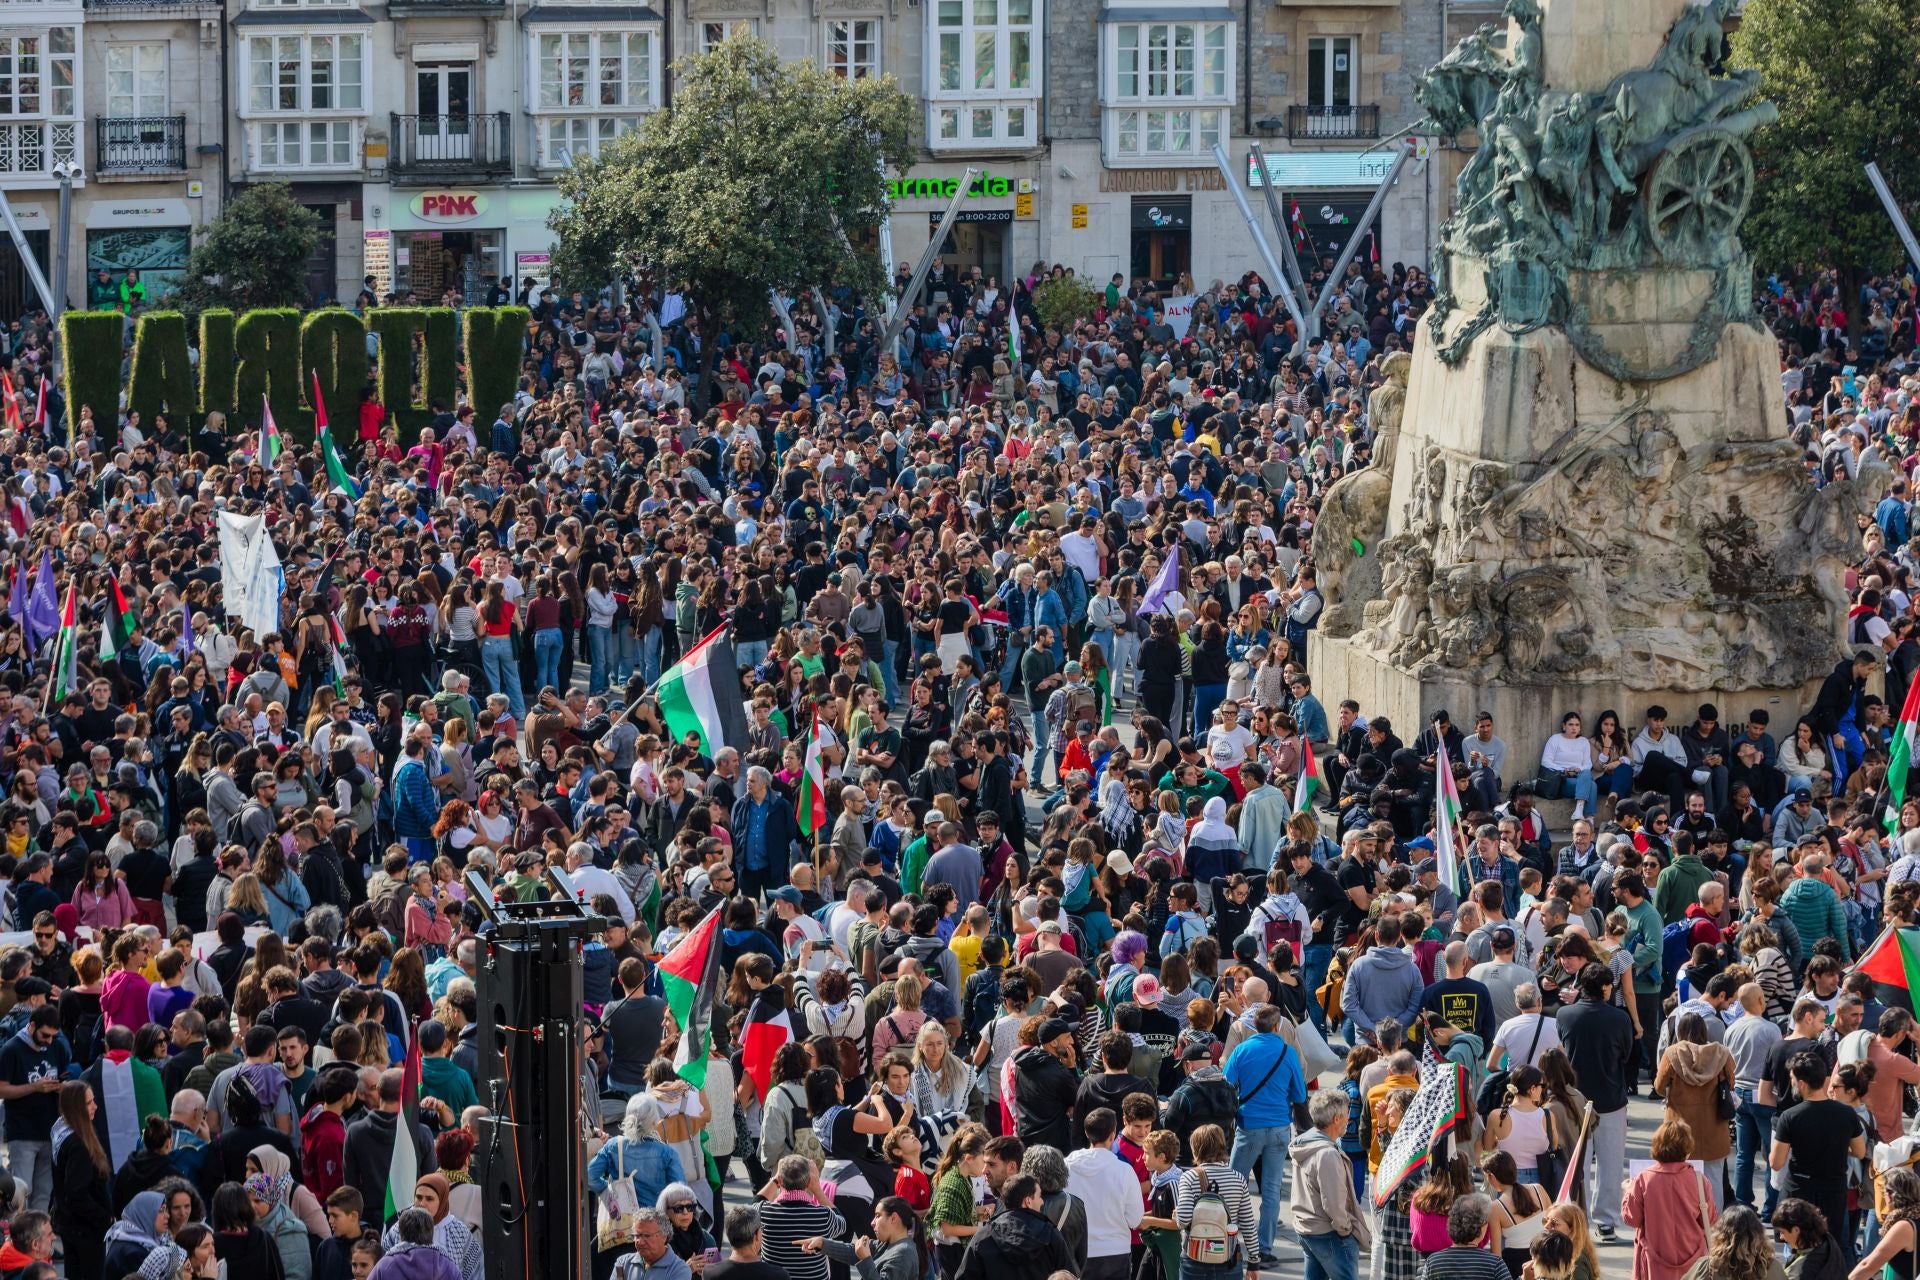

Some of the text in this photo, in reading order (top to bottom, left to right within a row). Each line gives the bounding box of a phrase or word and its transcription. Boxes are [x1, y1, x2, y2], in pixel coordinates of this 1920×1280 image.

[886, 170, 1009, 199] armacia
[1099, 170, 1227, 192] LANDABURU ETXEA
[965, 212, 1010, 221] 9:00-22:00
